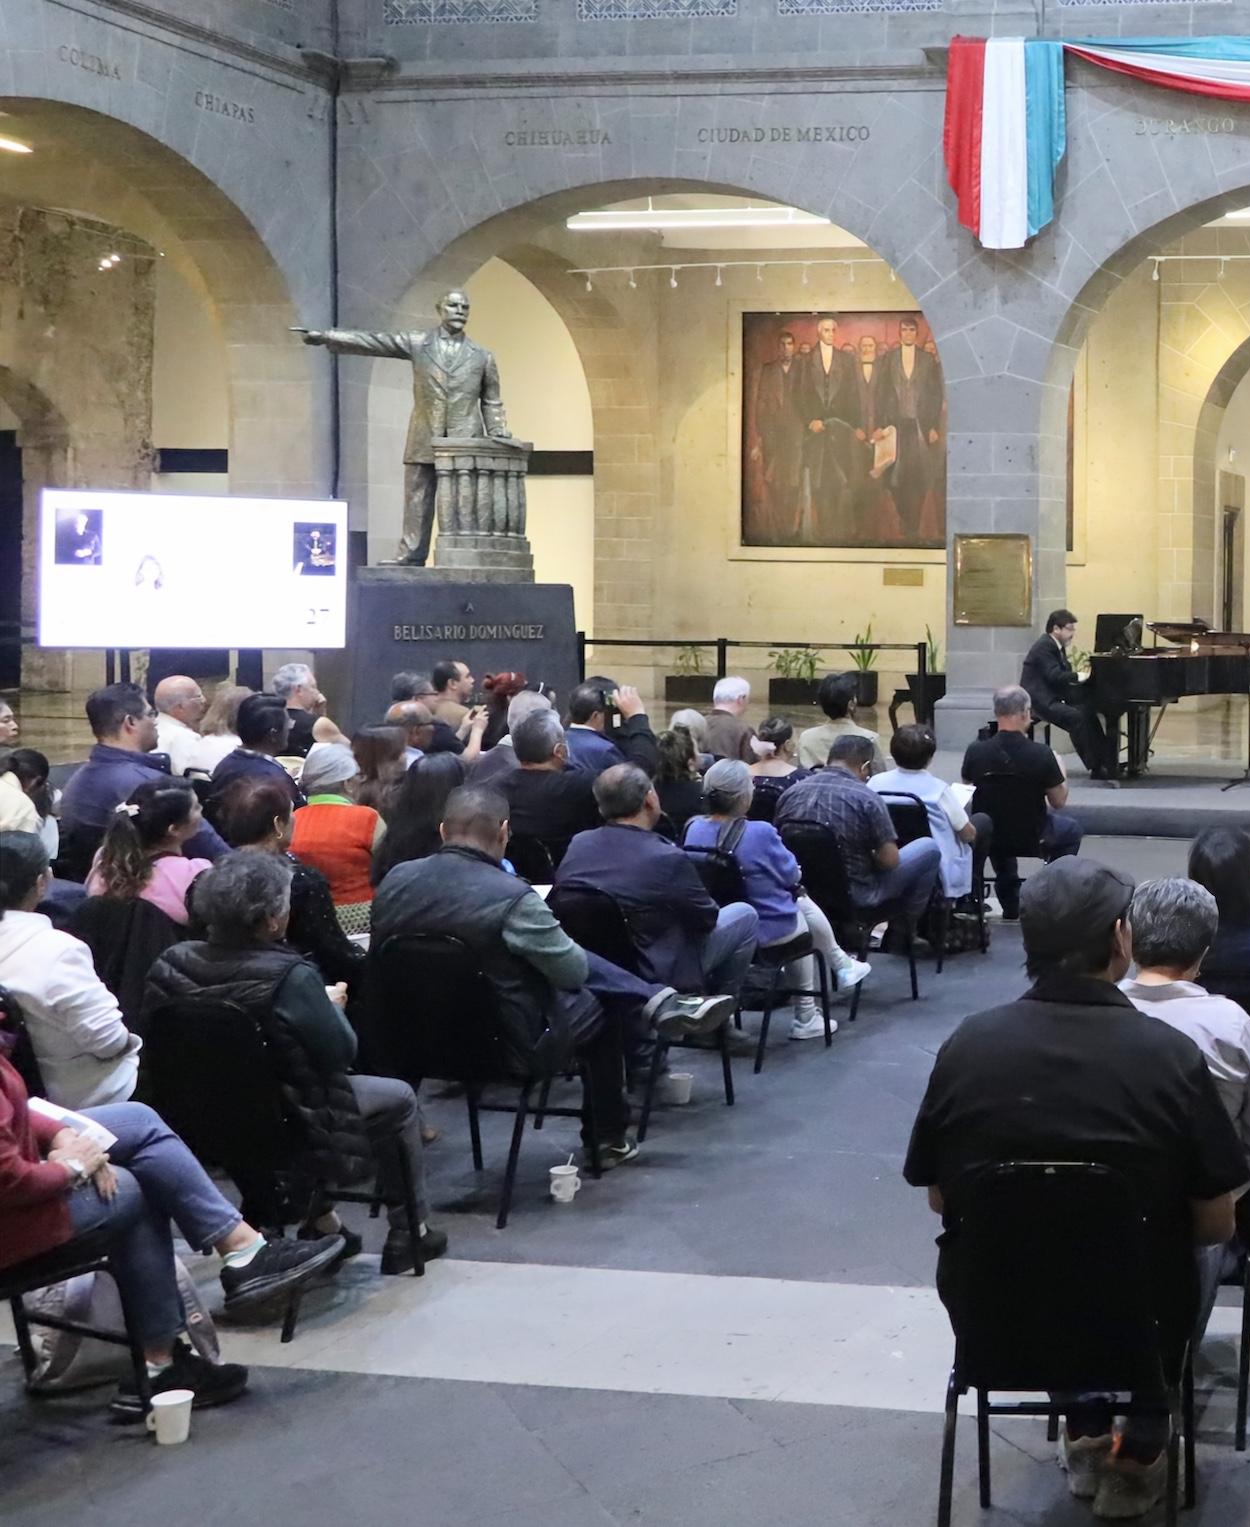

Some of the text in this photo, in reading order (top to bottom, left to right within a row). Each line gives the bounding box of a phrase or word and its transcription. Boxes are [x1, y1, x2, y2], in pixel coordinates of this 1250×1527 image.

[194, 91, 255, 124] CHIAPAS
[504, 128, 613, 147] CHIHUAHUA
[696, 126, 871, 144] CIUDAD DE MEXICO
[465, 602, 475, 612] A
[393, 623, 545, 641] BELISARIO DOMINGUEZ
